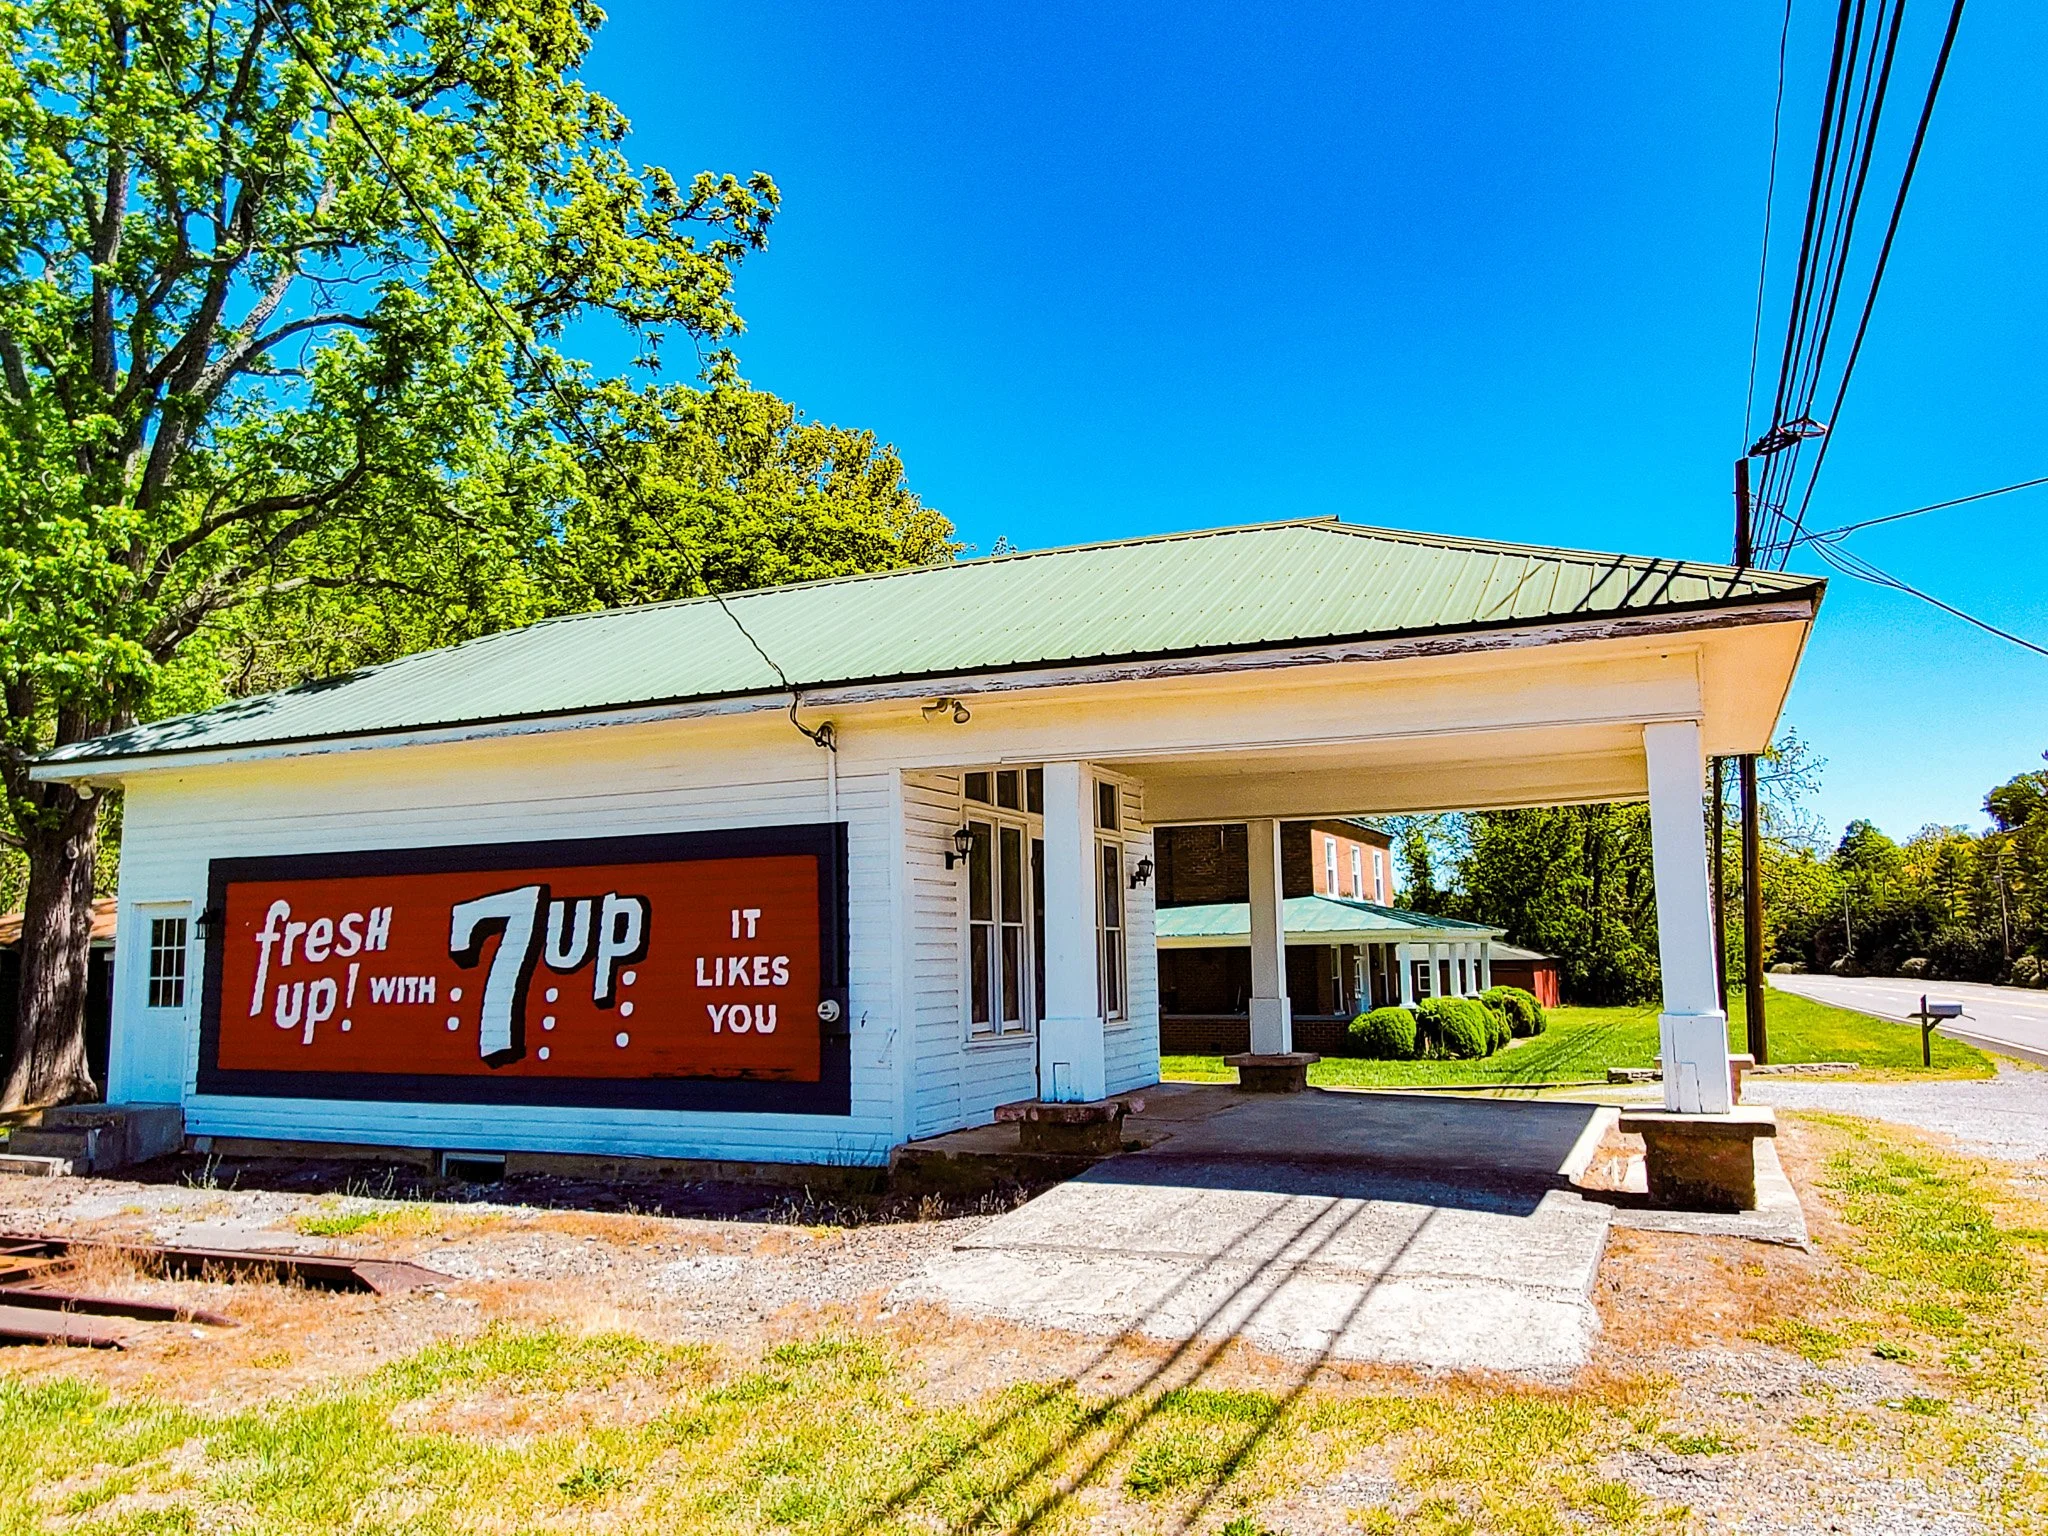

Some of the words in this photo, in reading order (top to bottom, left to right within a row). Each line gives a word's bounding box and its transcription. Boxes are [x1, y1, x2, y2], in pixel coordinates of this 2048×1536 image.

[731, 908, 761, 939] IT
[696, 956, 790, 987] LIKES
[275, 962, 360, 1044] up!
[370, 976, 436, 1004] WITH
[706, 1004, 777, 1034] YOU
